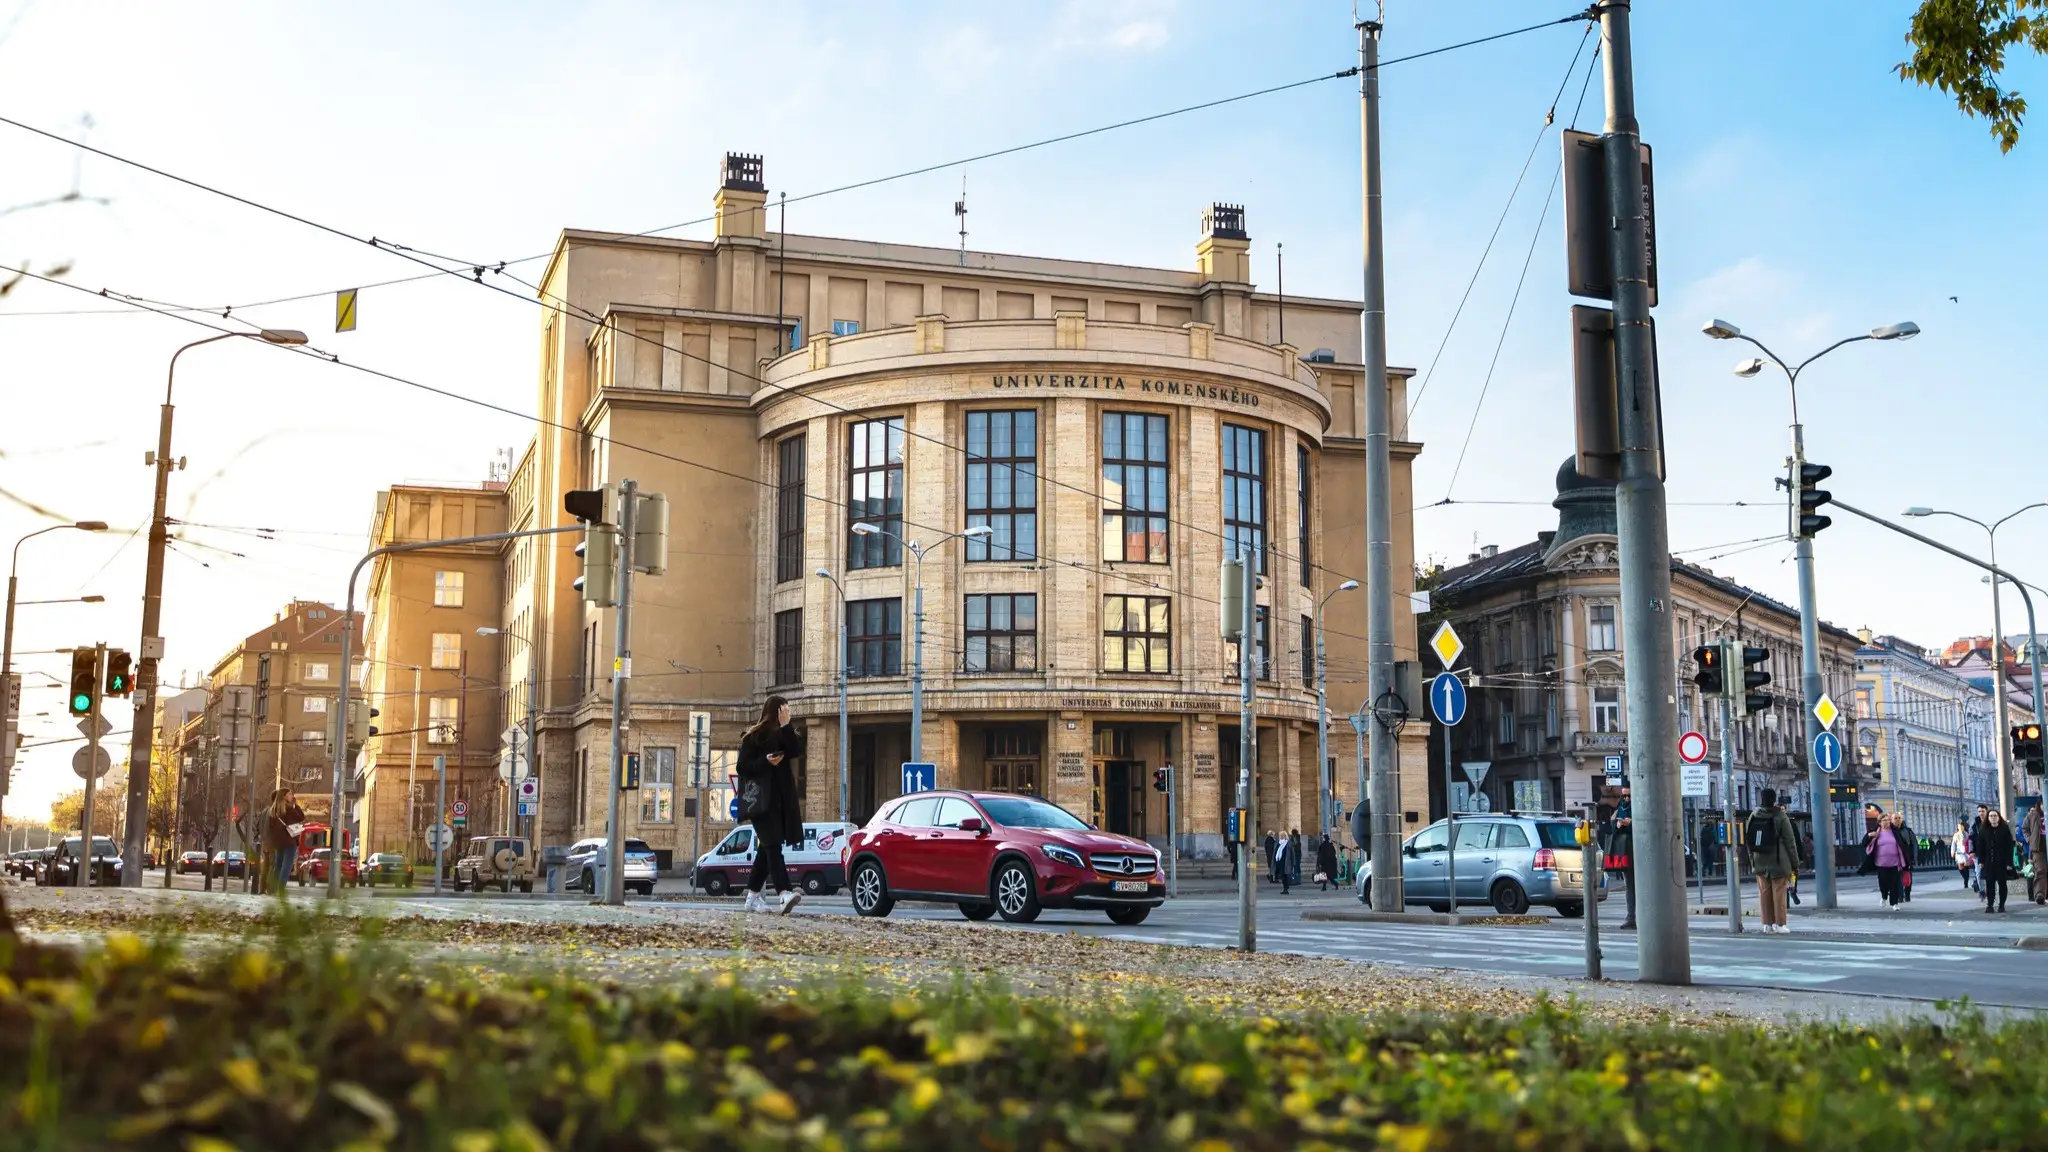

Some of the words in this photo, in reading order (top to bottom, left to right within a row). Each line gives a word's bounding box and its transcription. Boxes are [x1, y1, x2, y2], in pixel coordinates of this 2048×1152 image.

[1642, 185, 1649, 199] 33
[1643, 220, 1651, 234] 26
[993, 375, 1126, 390] UNIVERZITA
[1141, 378, 1260, 408] KOMENSKÉHO
[1062, 698, 1112, 707] UNIVERSITAS
[1120, 699, 1163, 708] COMENIANA
[1170, 700, 1221, 710] BRATISLAVENSIS
[455, 804, 465, 812] 50
